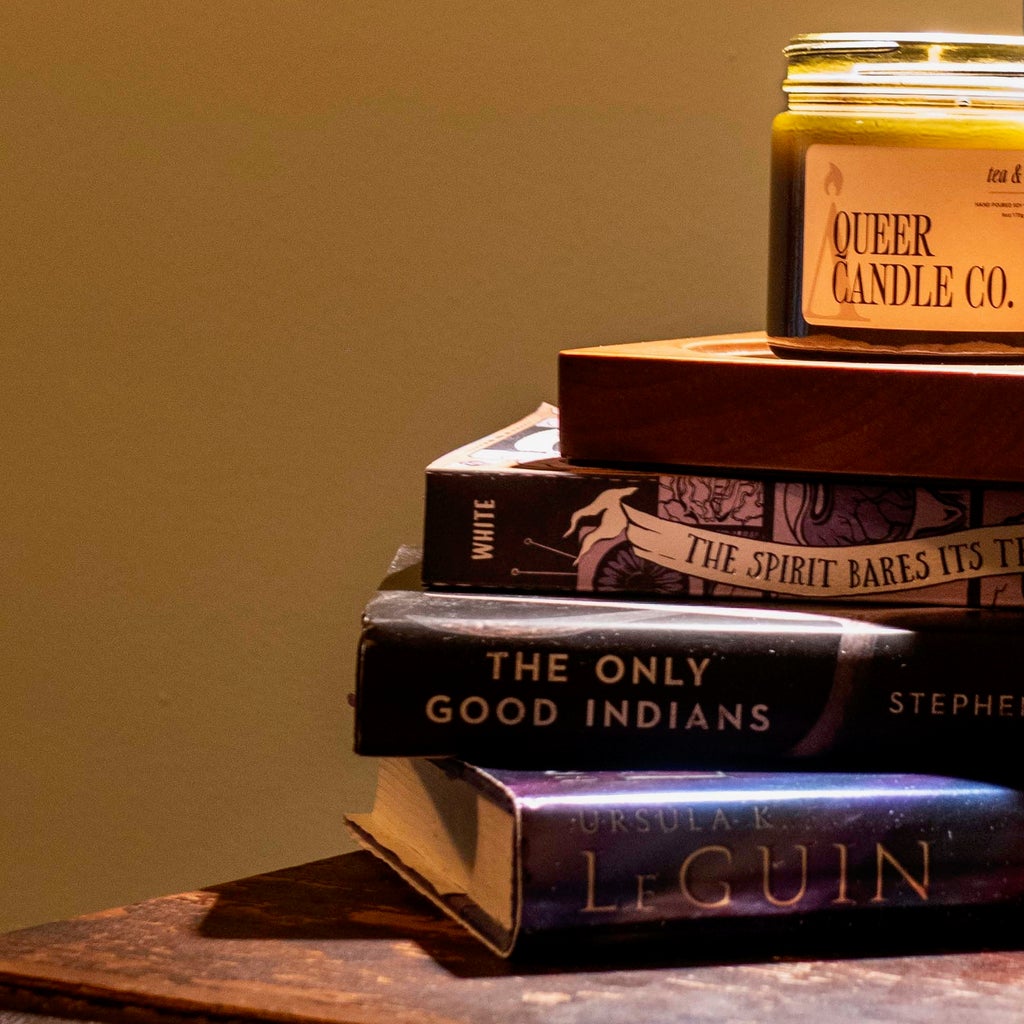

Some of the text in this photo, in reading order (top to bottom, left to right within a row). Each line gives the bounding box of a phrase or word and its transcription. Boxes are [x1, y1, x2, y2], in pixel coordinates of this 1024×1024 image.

[986, 166, 1008, 184] tea
[1010, 163, 1022, 184] &
[833, 210, 935, 258] QUEER
[832, 260, 1014, 309] CANDLE CO.
[471, 499, 495, 560] WHITE
[685, 533, 739, 575] THE
[746, 551, 838, 588] SPIRIT
[848, 549, 930, 589] BARES
[938, 541, 984, 577] ITS
[487, 651, 711, 687] THE ONLY
[425, 694, 771, 732] GOOD INDIANS
[578, 808, 734, 834] URSULA
